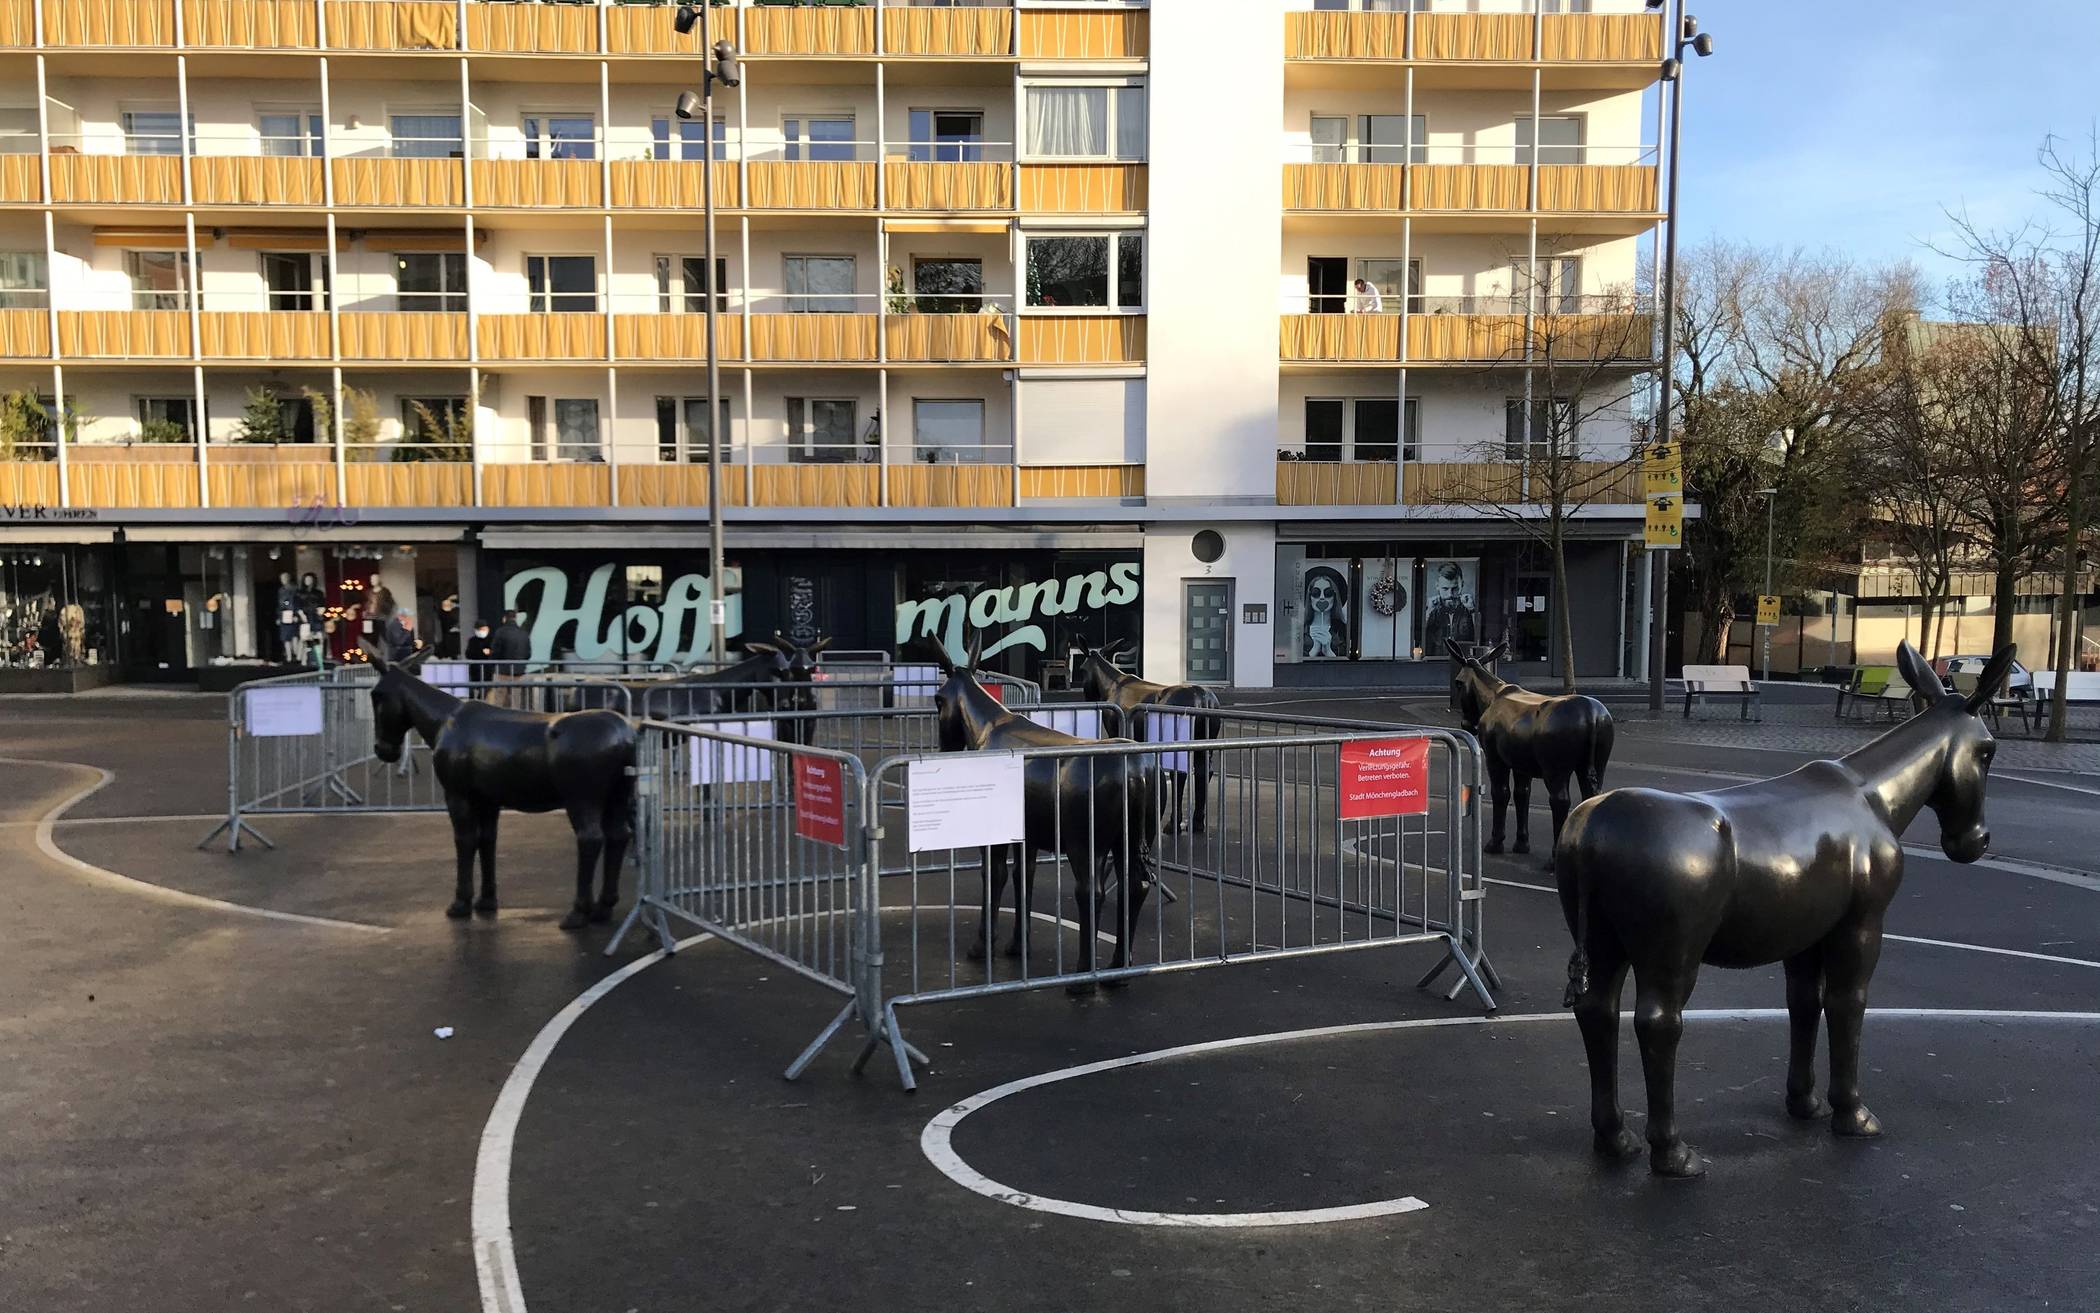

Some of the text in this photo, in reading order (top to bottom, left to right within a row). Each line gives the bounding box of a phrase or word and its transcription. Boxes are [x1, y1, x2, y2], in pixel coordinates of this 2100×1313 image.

[0, 503, 47, 519] VER
[1205, 565, 1213, 575] 3
[896, 562, 1140, 668] manns
[1369, 748, 1401, 758] Achtung
[1357, 774, 1383, 782] Betreten
[1349, 789, 1419, 801] Stadt Mönchengladbach
